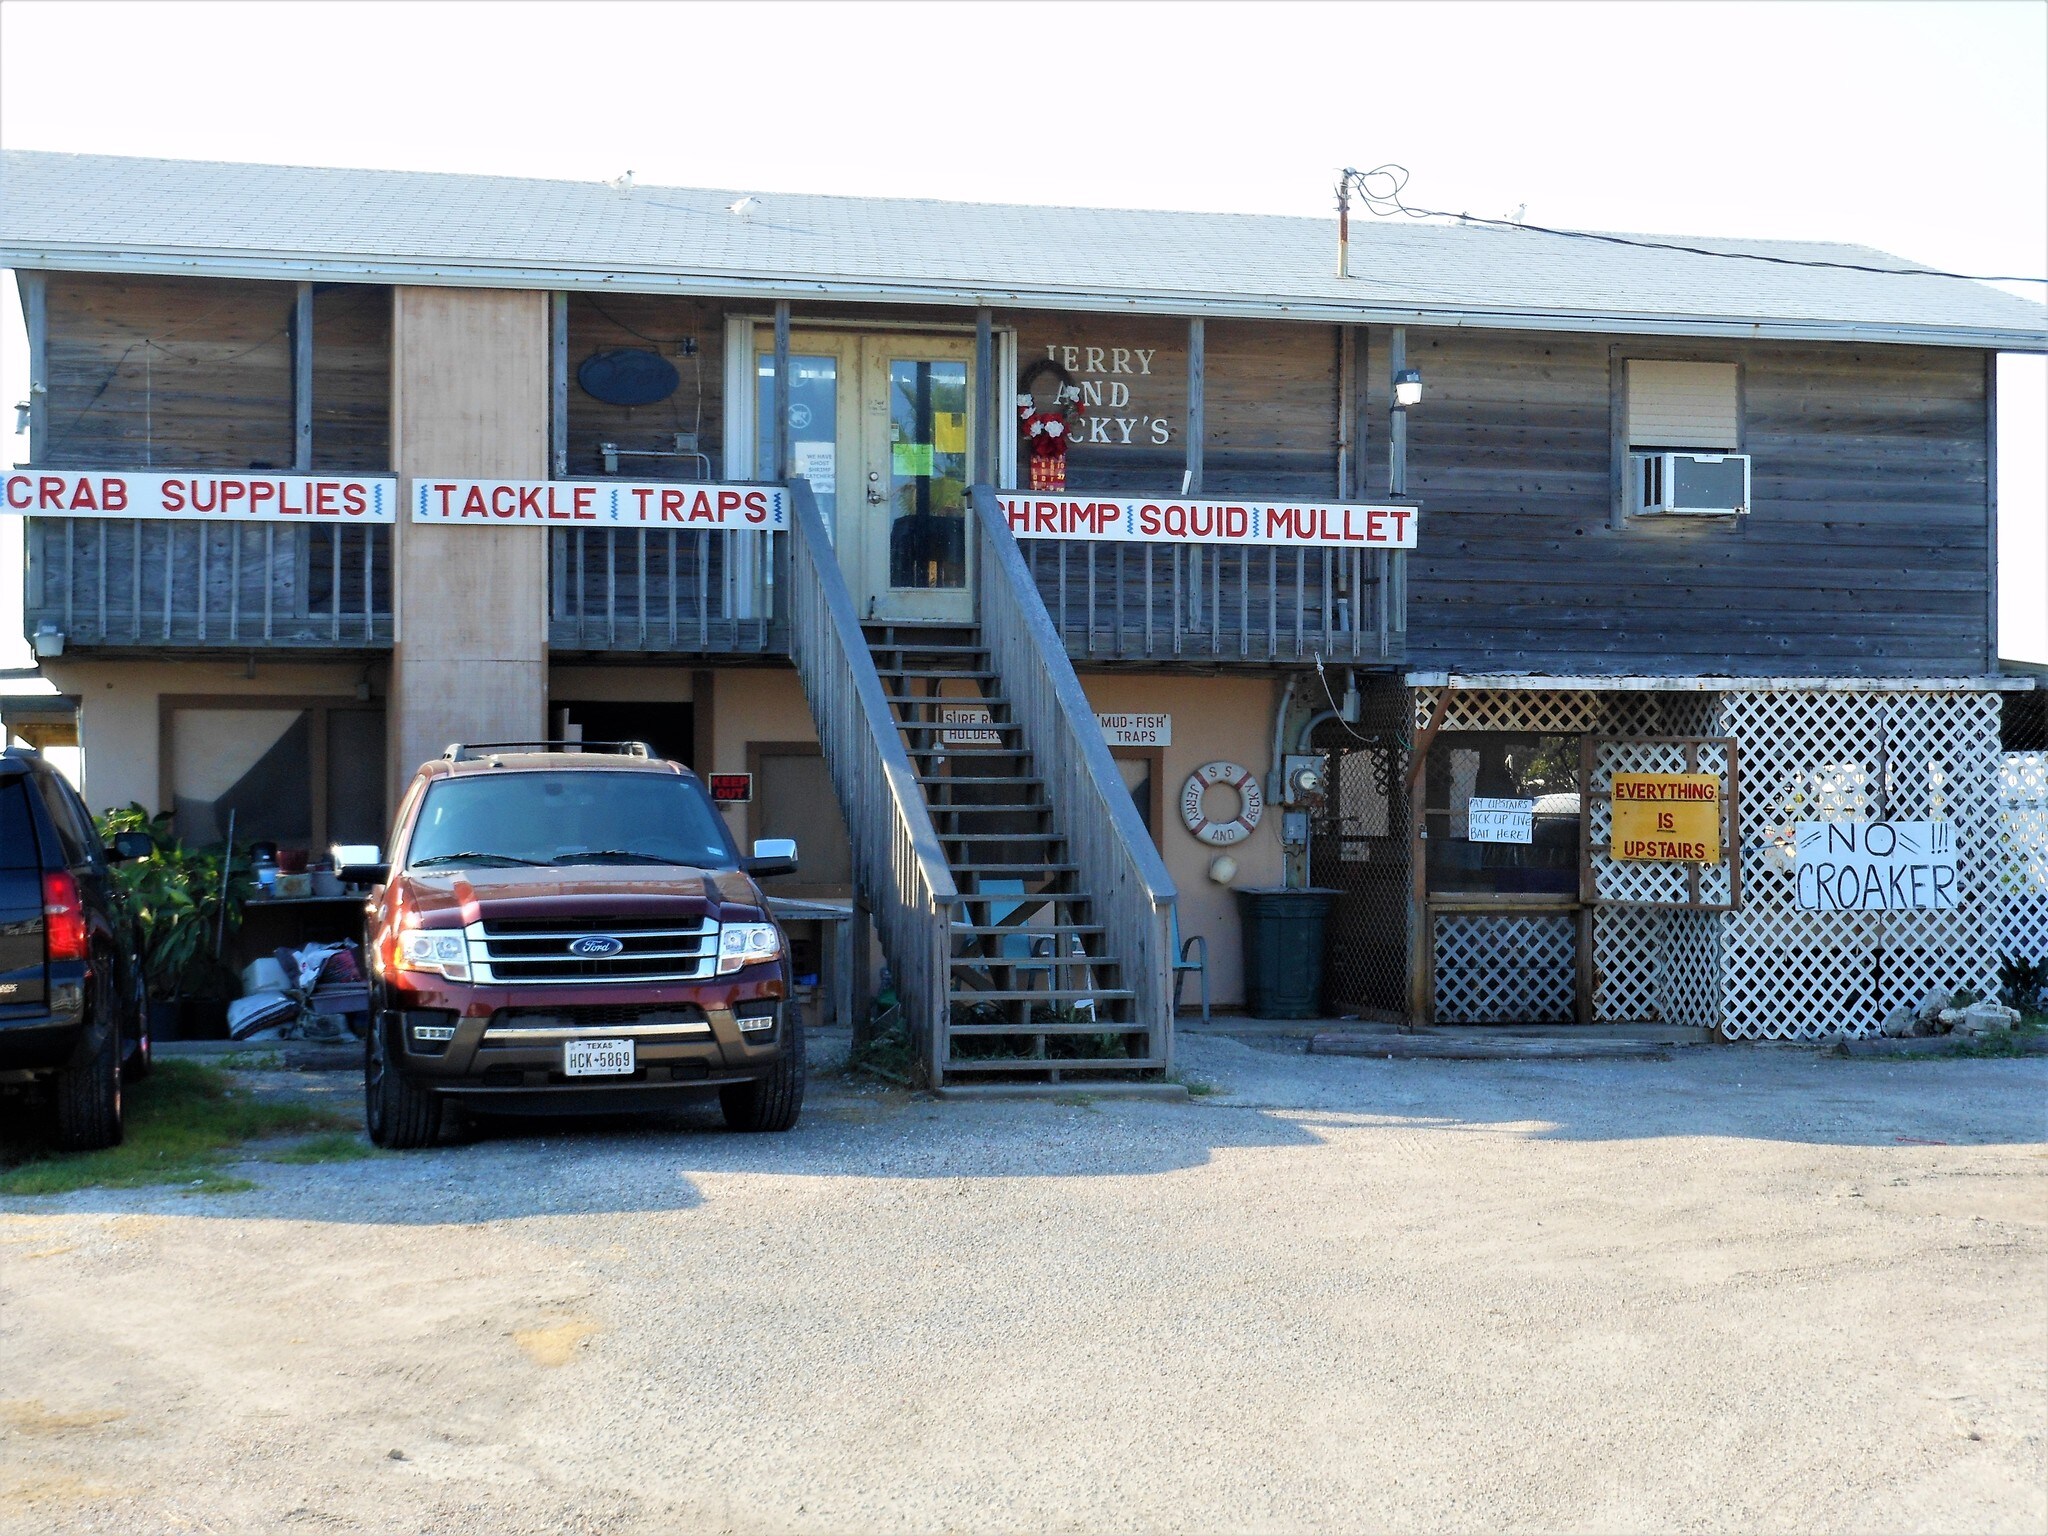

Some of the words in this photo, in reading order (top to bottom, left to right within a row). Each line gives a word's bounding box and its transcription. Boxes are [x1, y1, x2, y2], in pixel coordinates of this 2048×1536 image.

[1052, 380, 1130, 408] AND
[6, 475, 129, 511] CRAB
[161, 479, 367, 516] SUPPLIES
[434, 485, 597, 520] TACKLE
[631, 488, 768, 524] TRAPS
[998, 500, 1121, 535] HRIMP
[1139, 505, 1248, 538] SQUID
[1266, 508, 1412, 543] MULLET
[1116, 731, 1157, 743] TRAPS
[713, 776, 749, 787] KEEP
[1615, 782, 1715, 800] EVERYTHING
[716, 787, 745, 799] OUT
[1185, 783, 1201, 822] JERRY
[1244, 783, 1261, 823] BECKY
[1470, 798, 1484, 809] PAY
[1488, 799, 1529, 810] UPSTAIRS
[1470, 813, 1490, 825] PICK
[1493, 814, 1509, 825] UP
[1657, 812, 1674, 829] IS
[1211, 828, 1235, 842] AND
[1470, 827, 1490, 840] BAIT
[1828, 822, 1897, 857] NO
[1624, 840, 1706, 859] UPSTAIRS
[1797, 862, 1956, 910] CROAKER
[582, 939, 610, 953] Ford
[586, 1042, 613, 1050] TEXAS
